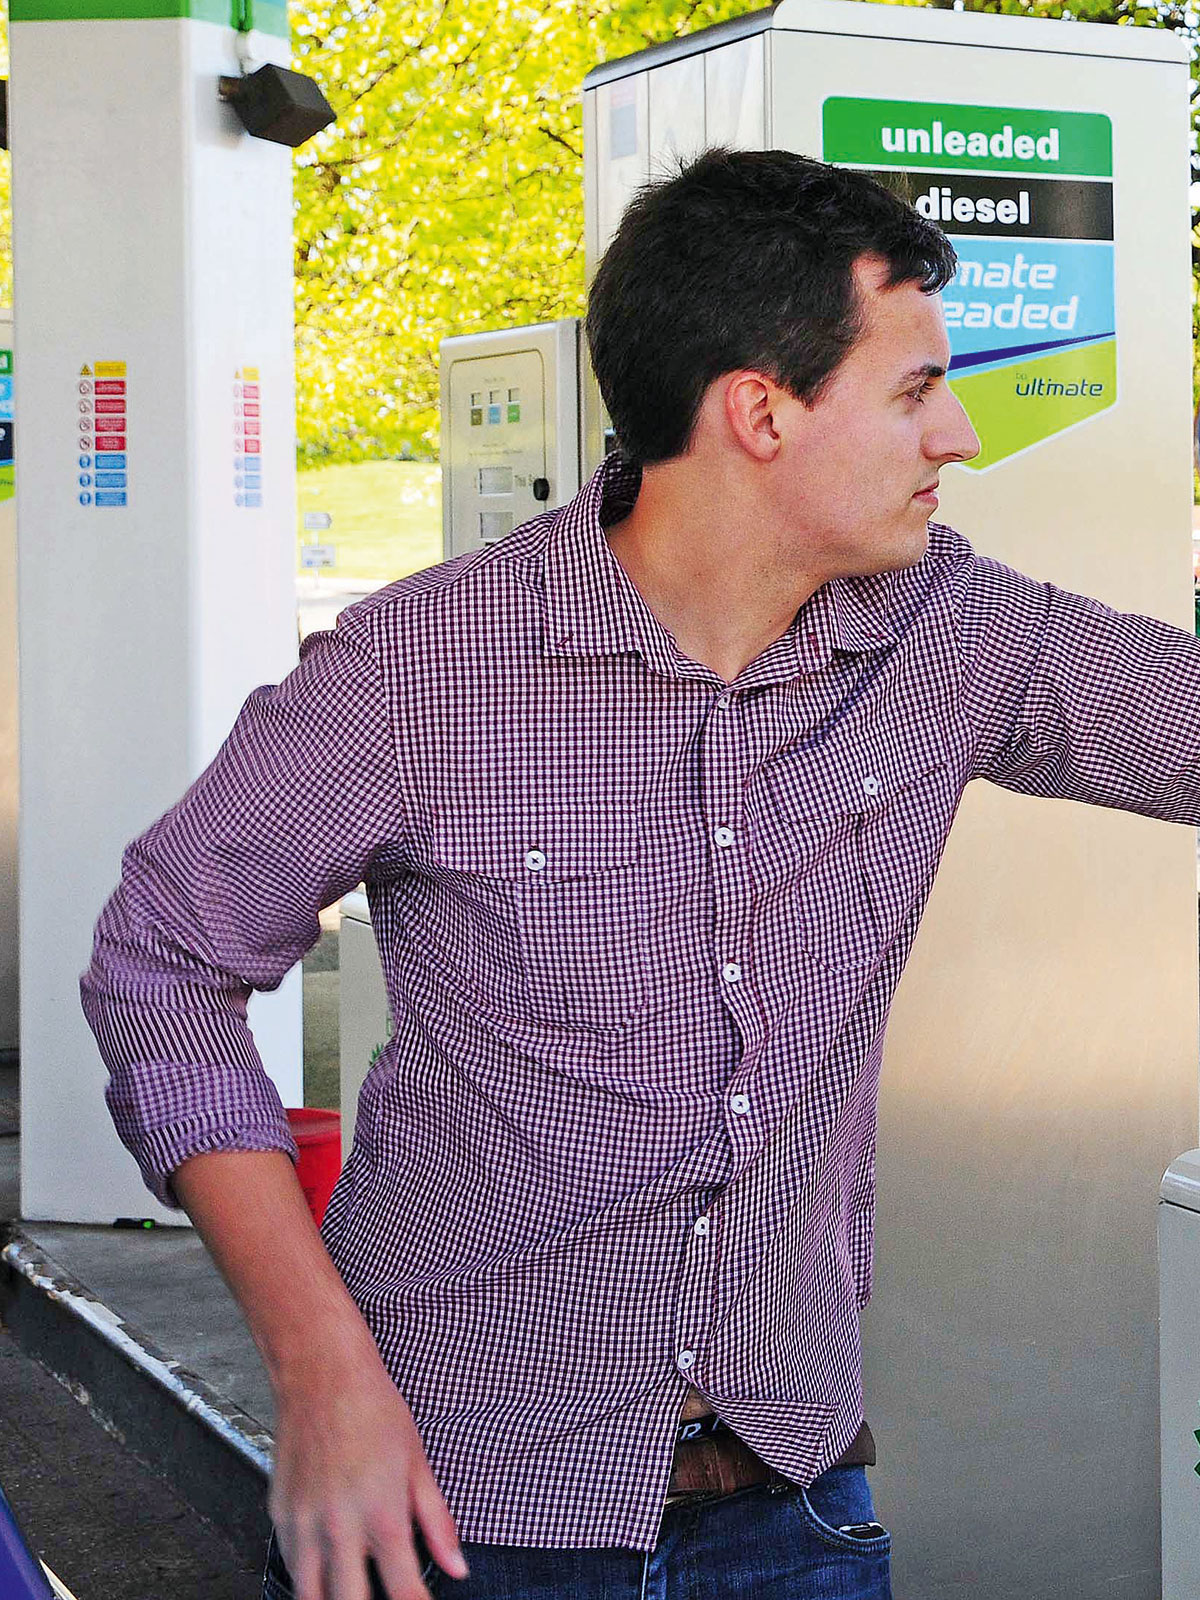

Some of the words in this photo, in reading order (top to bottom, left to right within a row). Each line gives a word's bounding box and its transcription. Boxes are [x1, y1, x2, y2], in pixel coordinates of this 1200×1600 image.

[882, 121, 1059, 161] unleaded
[915, 187, 1030, 224] diesel
[950, 254, 1056, 289] mate
[944, 296, 1078, 330] eaded
[1015, 377, 1103, 397] ultimate
